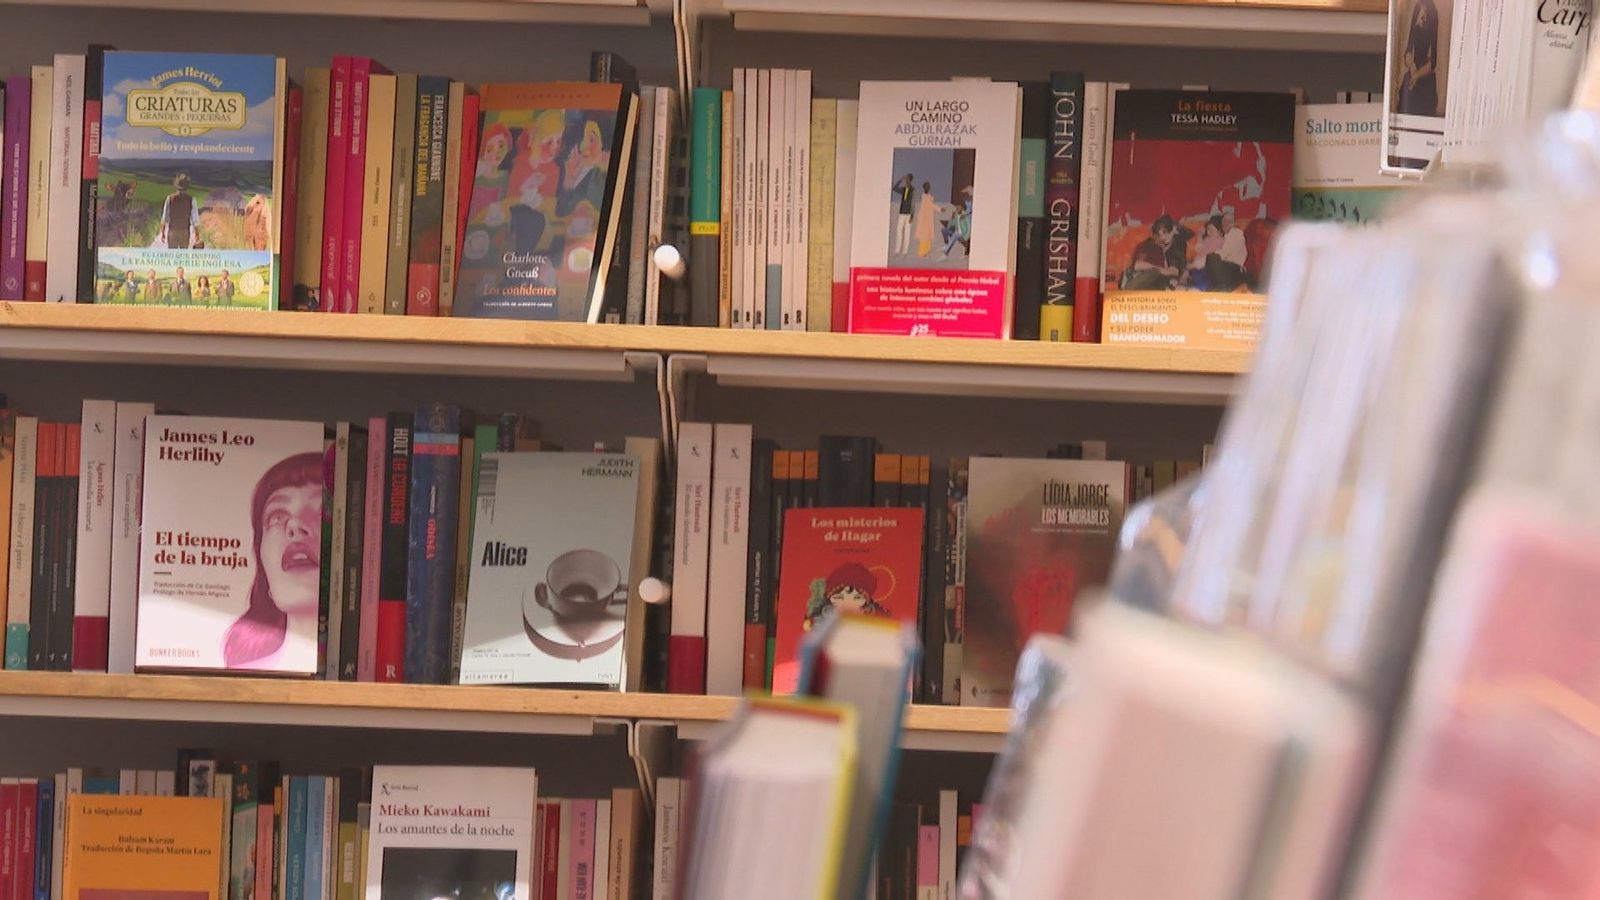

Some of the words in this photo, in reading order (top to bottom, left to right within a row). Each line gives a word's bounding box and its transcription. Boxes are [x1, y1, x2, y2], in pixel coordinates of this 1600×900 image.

[151, 69, 183, 86] James
[184, 66, 223, 88] Herriot
[135, 96, 237, 113] CRIATURAS
[905, 100, 923, 111] UN
[926, 100, 969, 112] LARGO
[1179, 100, 1191, 111] La
[1195, 100, 1231, 111] fiesta
[140, 112, 179, 120] GRANDES
[186, 112, 232, 122] PEQUEÑAS
[432, 95, 444, 140] FRANCESCA
[911, 112, 962, 123] CAMINO
[1171, 113, 1199, 123] TESSA
[1201, 114, 1237, 124] HADLEY
[894, 123, 977, 135] ABDULRAZAK
[1053, 90, 1075, 160] JOHN
[1306, 118, 1342, 134] Salto
[1346, 119, 1382, 133] mort
[909, 135, 961, 146] GURNAH
[1306, 138, 1356, 147] MACDONALD
[1358, 138, 1381, 146] HARR
[147, 141, 172, 151] bello
[180, 143, 255, 154] resplandeciente
[122, 257, 133, 265] LA
[135, 258, 172, 266] FAMOSA
[173, 259, 199, 267] SERIE
[200, 260, 242, 268] INGLESA
[503, 251, 548, 264] Charlotte
[505, 266, 539, 278] Gneuß
[957, 276, 978, 284] Premio
[979, 277, 999, 285] Nobel
[502, 283, 557, 296] confidentes
[1110, 313, 1129, 323] DEL
[1133, 313, 1169, 324] DESEO
[1109, 333, 1186, 344] TRANSFORMADOR
[159, 428, 217, 444] James
[222, 431, 255, 447] Leo
[393, 428, 408, 456] HOLT
[159, 446, 225, 466] Herlihy
[598, 459, 633, 467] JUDITH
[582, 469, 632, 478] HERMANN
[1043, 479, 1071, 506] LÍDIA
[1074, 484, 1109, 507] JORGE
[809, 517, 834, 528] Los
[836, 516, 897, 528] misterios
[1041, 508, 1057, 525] LOS
[1057, 508, 1110, 526] MEMORABLES
[155, 531, 172, 546] El
[177, 531, 241, 551] tiempo
[824, 531, 839, 542] de
[841, 531, 881, 543] Hagar
[154, 550, 176, 564] de
[181, 550, 196, 565] la
[201, 551, 248, 570] bruja
[481, 541, 528, 567] Alice
[82, 807, 92, 815] La
[94, 807, 143, 816] singularidad
[379, 804, 419, 817] Mieko
[423, 805, 490, 817] Kawakami
[378, 822, 397, 834] Los
[400, 823, 447, 835] amantes
[450, 823, 464, 835] de
[467, 823, 477, 836] la
[480, 824, 515, 837] noche
[82, 844, 123, 853] Traducción
[125, 845, 134, 853] de
